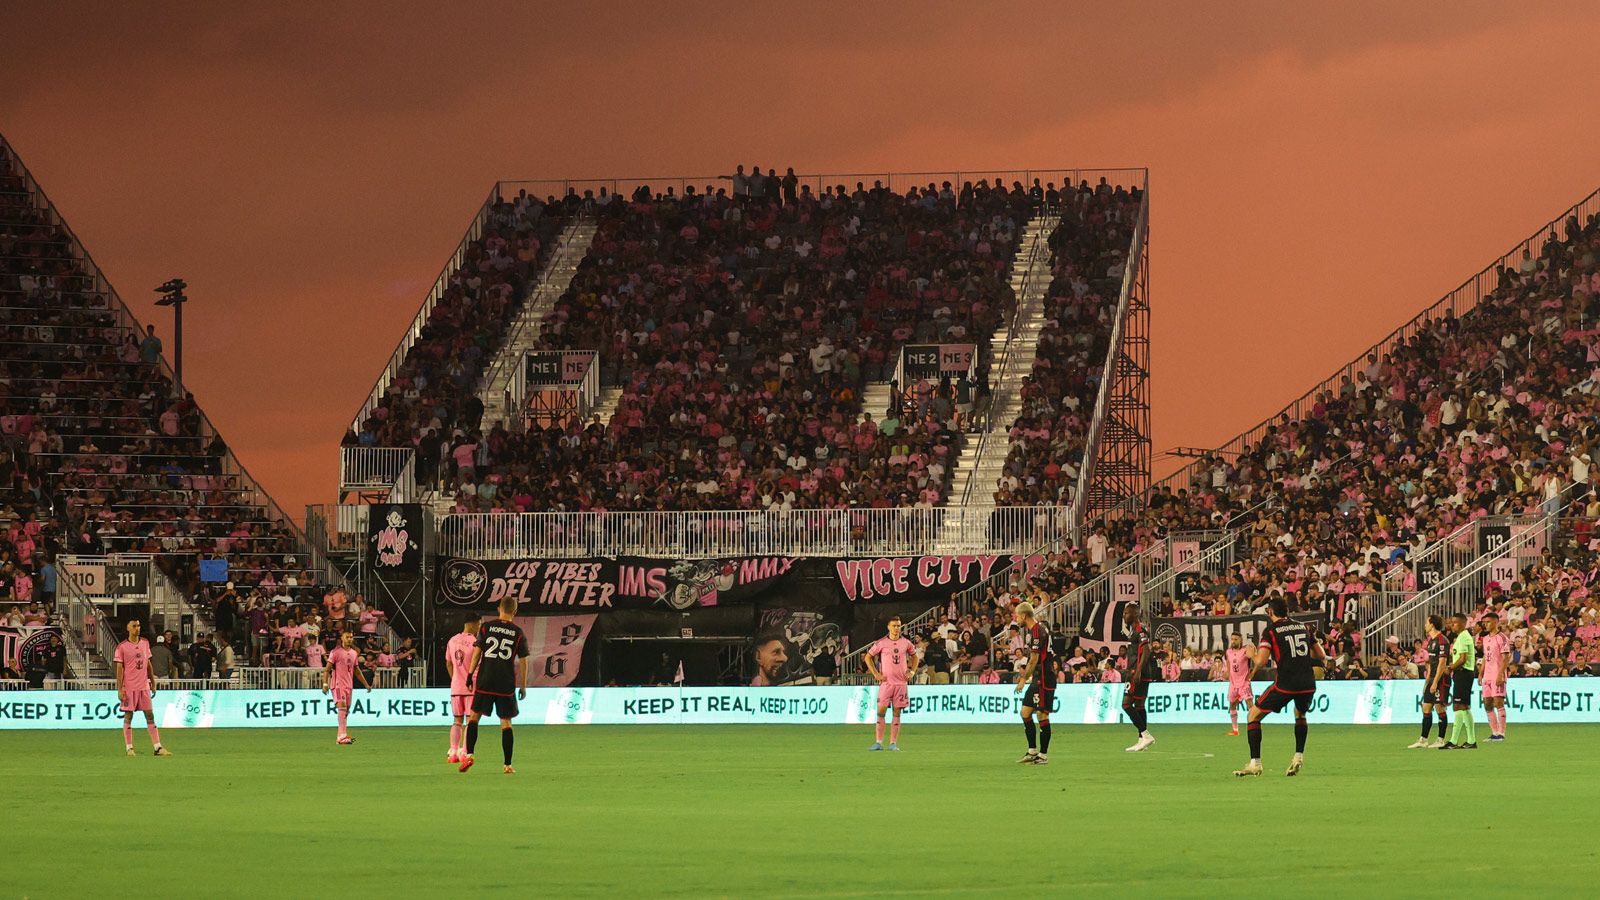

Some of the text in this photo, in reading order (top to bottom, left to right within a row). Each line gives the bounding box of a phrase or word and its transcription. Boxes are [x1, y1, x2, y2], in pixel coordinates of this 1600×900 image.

[908, 353, 937, 365] NE 2
[944, 353, 961, 363] NE
[1486, 534, 1503, 550] 113
[72, 572, 95, 587] 110
[117, 572, 136, 587] 111
[505, 561, 602, 581] LOS PIBES
[836, 557, 912, 601] VICE
[916, 555, 998, 588] CITY
[1421, 571, 1441, 585] 113
[1495, 568, 1513, 580] 114
[618, 564, 668, 598] IMS
[1118, 583, 1135, 595] 112
[487, 578, 616, 608] DEL INTER
[489, 625, 516, 637] HOPKINS
[484, 636, 514, 661] 25
[1284, 633, 1309, 658] 15
[454, 648, 464, 667] 9
[246, 700, 295, 719] KEEP
[301, 699, 321, 716] IT
[326, 697, 381, 718] RAL,
[388, 699, 436, 717] KEEP
[624, 695, 829, 716] KEEP IT REAL, KEEP IT 100
[926, 695, 939, 712] IT
[941, 694, 975, 715] REAL,
[979, 696, 1010, 714] KEEP
[1175, 693, 1190, 711] IT
[1530, 690, 1571, 711] KEEP
[1576, 692, 1594, 712] IT
[0, 702, 48, 720] KEEP
[55, 703, 76, 719] IT
